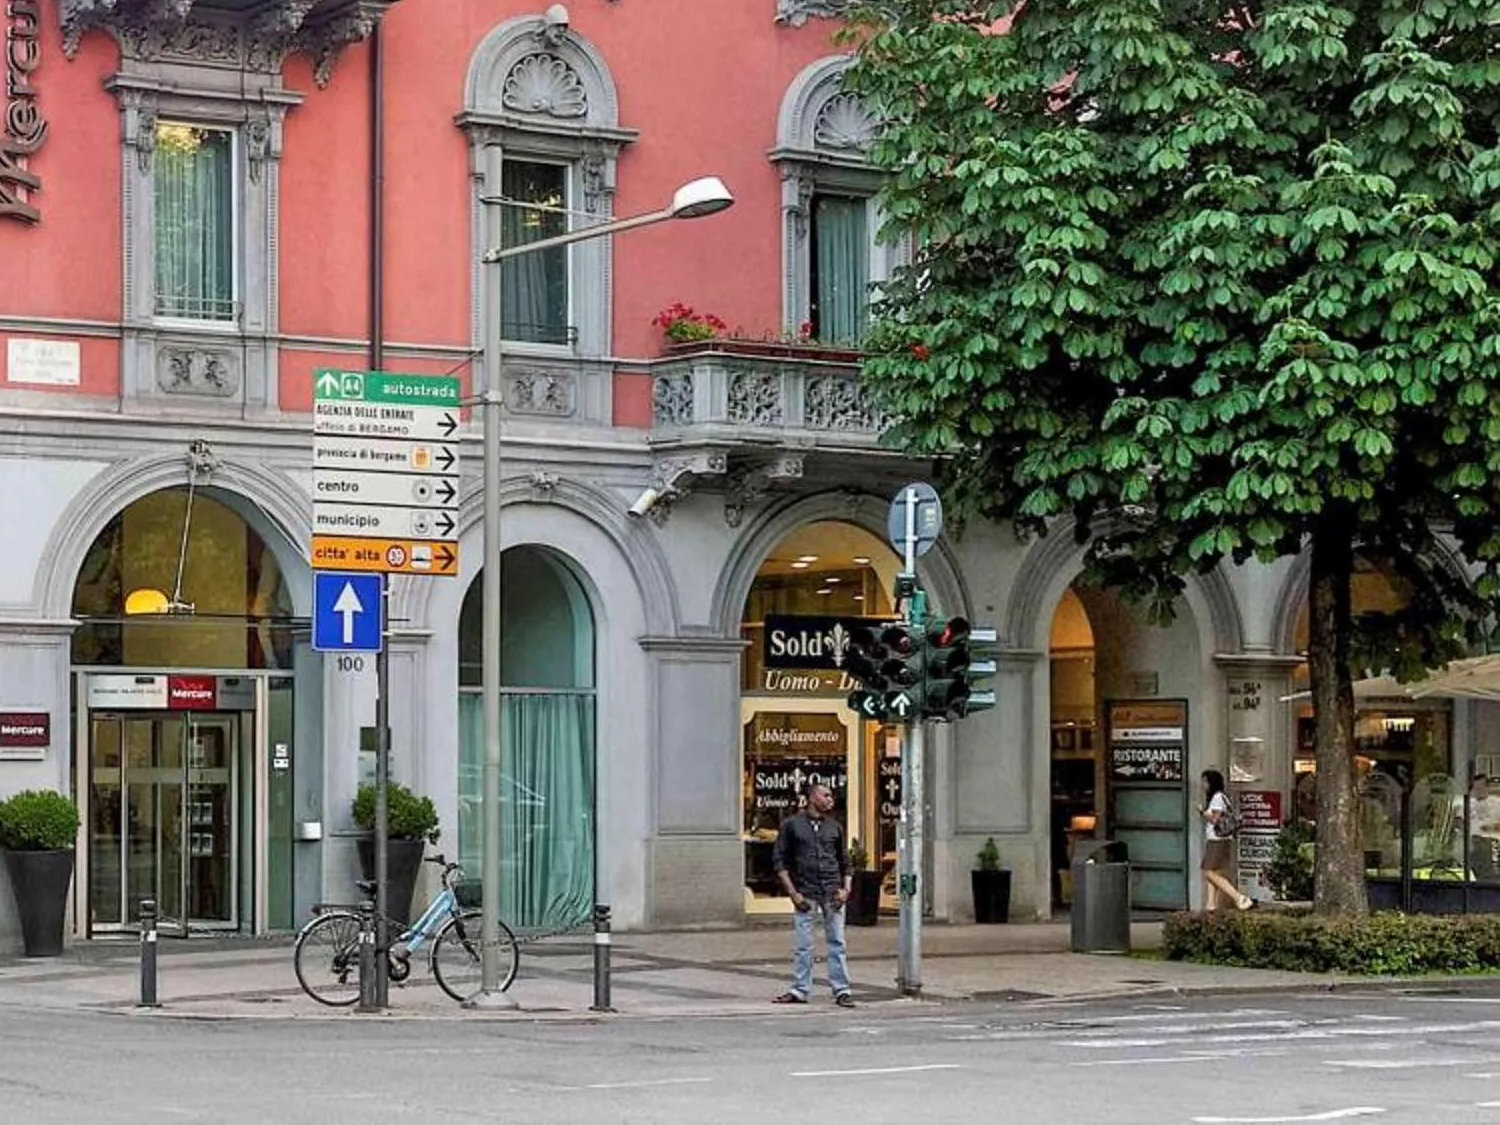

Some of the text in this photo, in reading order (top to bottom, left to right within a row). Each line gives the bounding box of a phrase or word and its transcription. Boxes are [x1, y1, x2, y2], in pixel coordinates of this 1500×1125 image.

[383, 383, 457, 398] autostrada
[317, 404, 414, 421] AGENZIA DELLE ENTRATE
[360, 424, 409, 435] BERGAMO
[317, 478, 359, 492] centro
[316, 514, 380, 527] municipio
[355, 548, 381, 561] alta
[770, 629, 823, 657] Sold
[338, 656, 363, 672] 100
[765, 670, 819, 690] Uomo
[172, 688, 213, 700] Mercure
[1, 724, 45, 736] Mercure
[757, 729, 840, 746] Abbigliamento
[1113, 748, 1181, 762] RISTORANTE
[755, 772, 789, 789] Sold
[756, 794, 790, 808] Uomo
